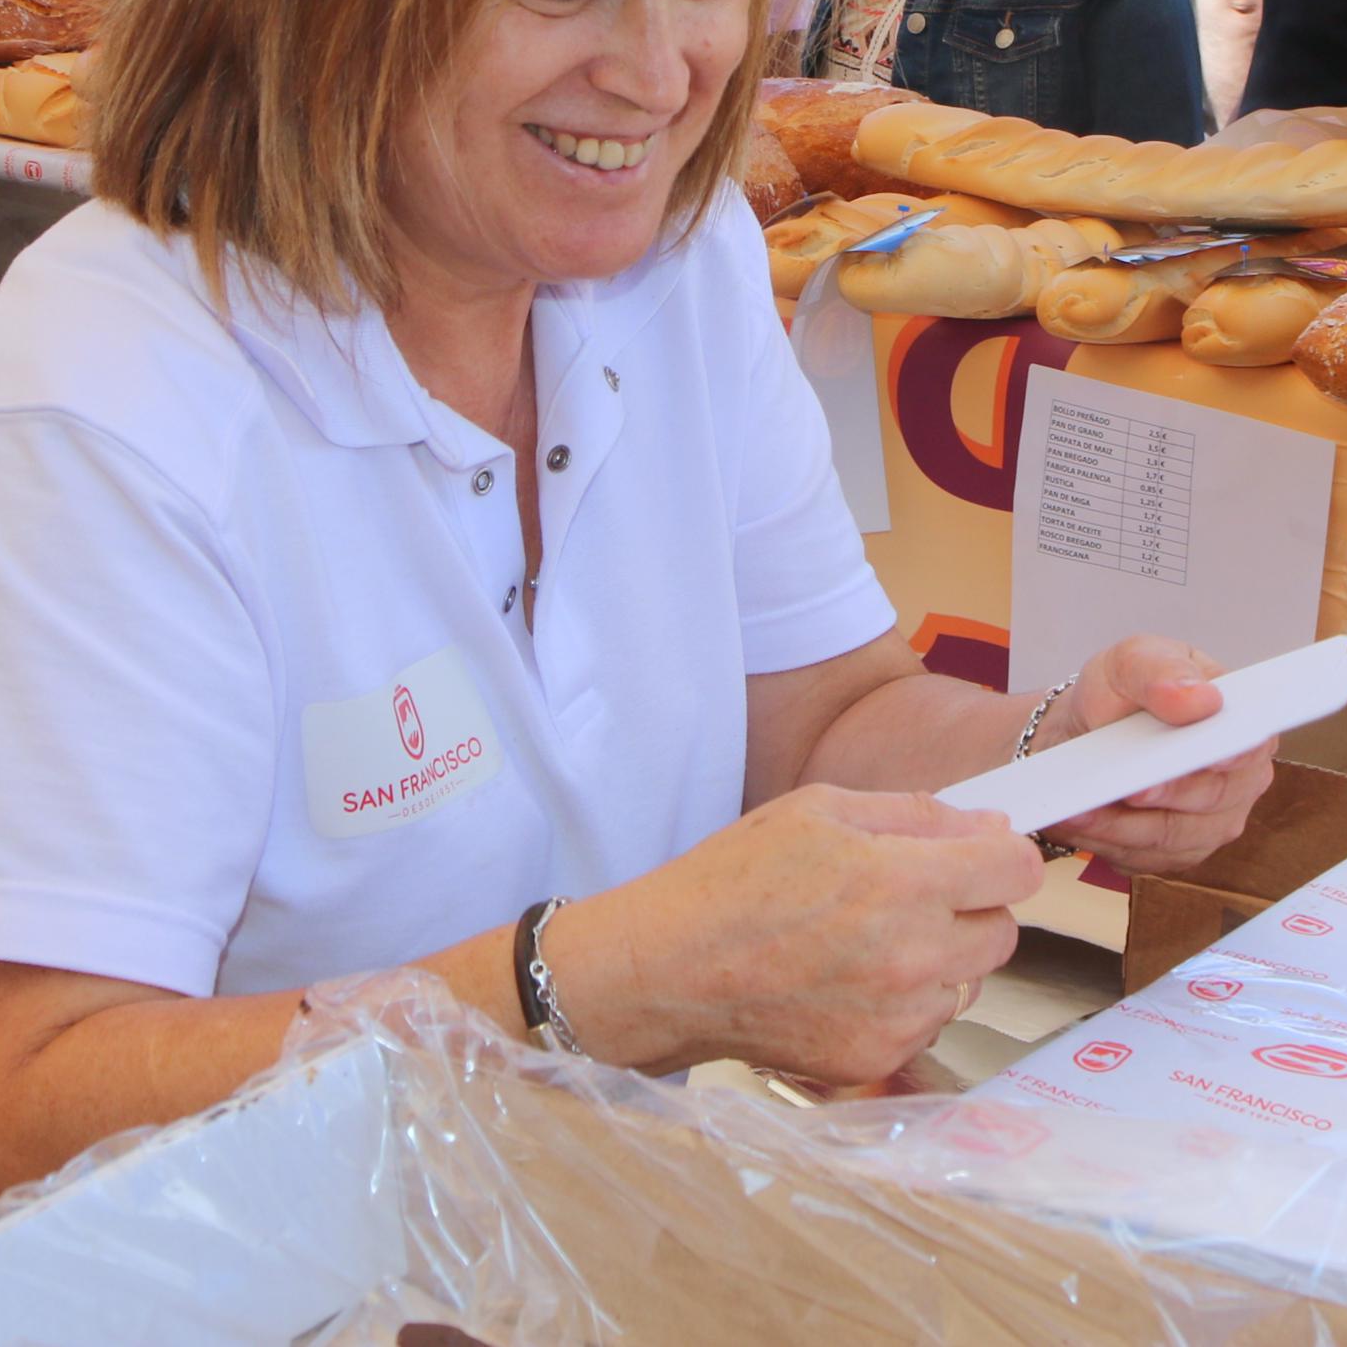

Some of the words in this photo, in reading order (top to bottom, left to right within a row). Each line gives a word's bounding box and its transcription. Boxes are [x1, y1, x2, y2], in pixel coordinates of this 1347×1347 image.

[1053, 404, 1076, 417] BOLLO
[1077, 409, 1110, 426] PREÑADO
[1052, 419, 1066, 429] PAN
[1067, 423, 1076, 431] DE
[1077, 425, 1104, 439] GRANO
[1049, 433, 1082, 448] CHAPATA
[1083, 441, 1092, 450] DE
[1093, 443, 1113, 456] MAIZ
[1047, 447, 1062, 457] PAN
[1063, 450, 1099, 466] BREGADO
[1045, 475, 1074, 488] RUSTICA
[1046, 461, 1076, 476] FABIOLA
[1077, 469, 1112, 484] PALENCIA
[1043, 488, 1058, 499] PAN
[1060, 493, 1069, 502] DE
[1070, 495, 1091, 507] MIGA
[1042, 502, 1076, 517] CHAPATA
[1041, 515, 1066, 529] TORTA
[1067, 521, 1076, 530] DE
[1077, 523, 1102, 537] ACEITE
[1040, 529, 1065, 542] ROSCO
[1066, 535, 1102, 550] BREGADO
[1039, 542, 1090, 561] FRANCISCANA
[342, 783, 395, 813] SAN
[399, 736, 483, 801] FRANCISCO
[1224, 949, 1330, 982] FRANCISCO
[1168, 1069, 1213, 1093] SAN
[1215, 1084, 1333, 1132] FRANCISCO
